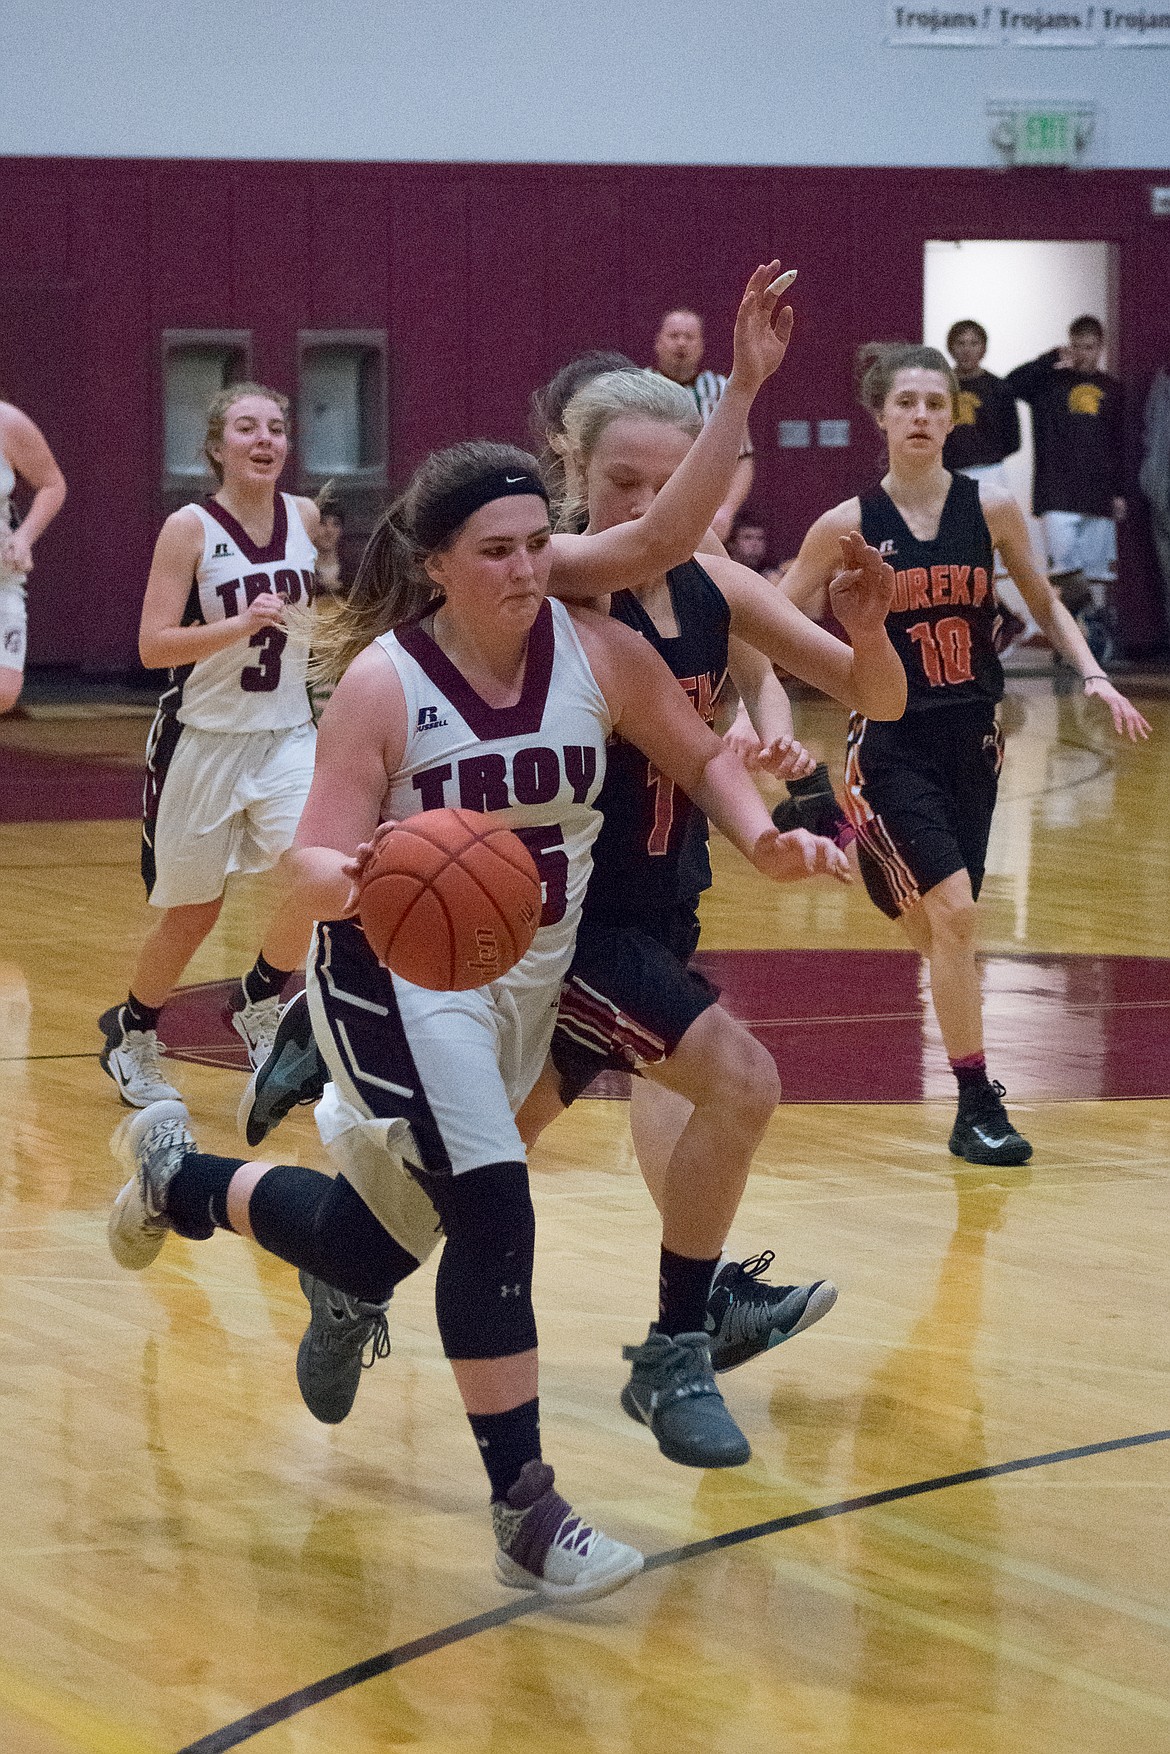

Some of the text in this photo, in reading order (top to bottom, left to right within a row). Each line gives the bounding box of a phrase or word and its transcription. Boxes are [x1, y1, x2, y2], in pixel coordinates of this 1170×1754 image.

[241, 626, 288, 692] 3
[906, 616, 976, 687] 10
[415, 719, 449, 732] USSELL
[412, 746, 597, 814] TROY
